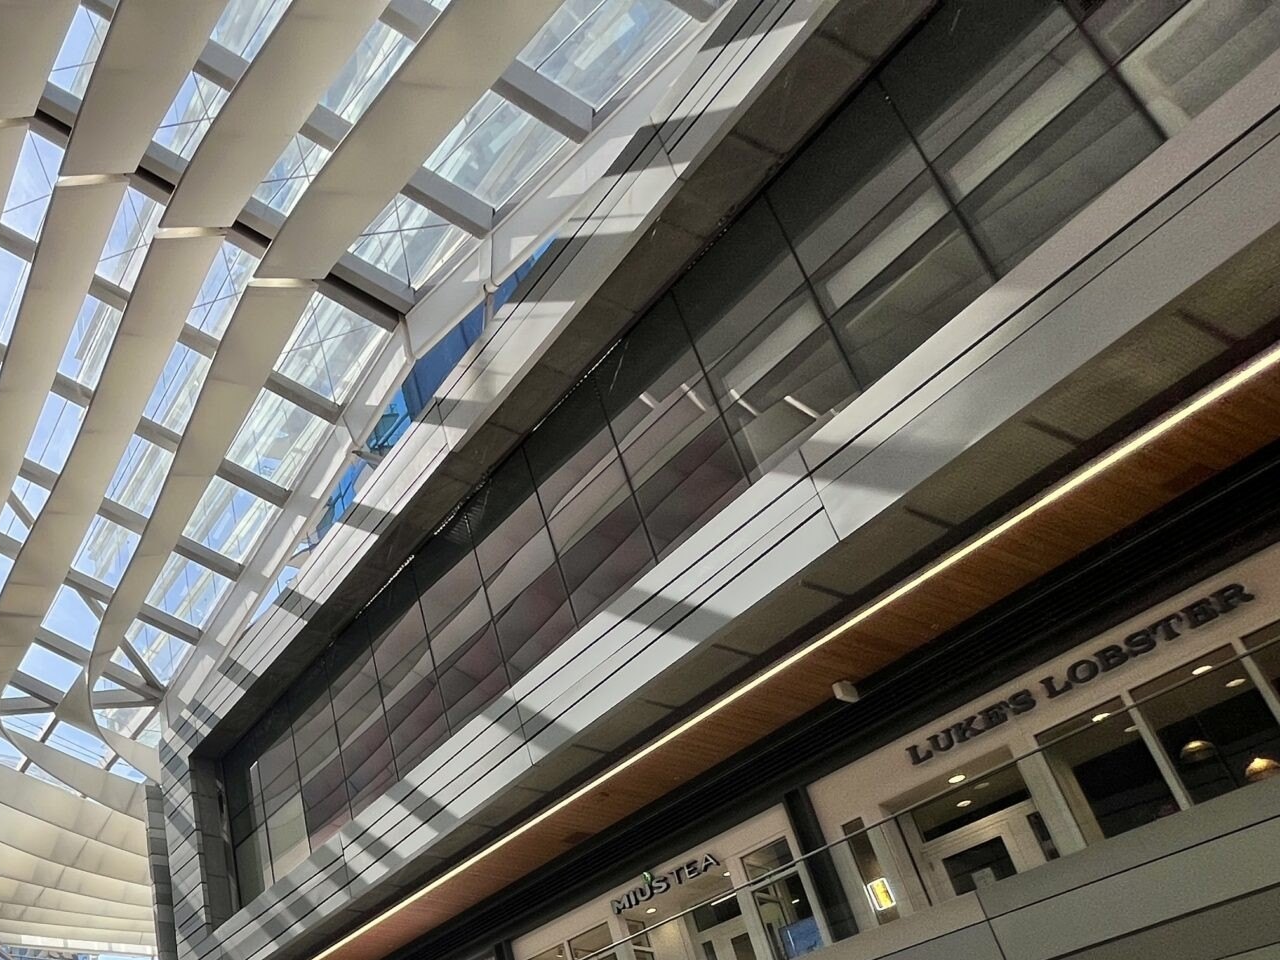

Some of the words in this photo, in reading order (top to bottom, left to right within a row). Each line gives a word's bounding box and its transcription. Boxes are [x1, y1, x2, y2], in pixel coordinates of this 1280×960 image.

[905, 688, 1037, 766] LUKE'S
[1039, 582, 1255, 700] LOBSTER
[668, 853, 721, 884] TEA
